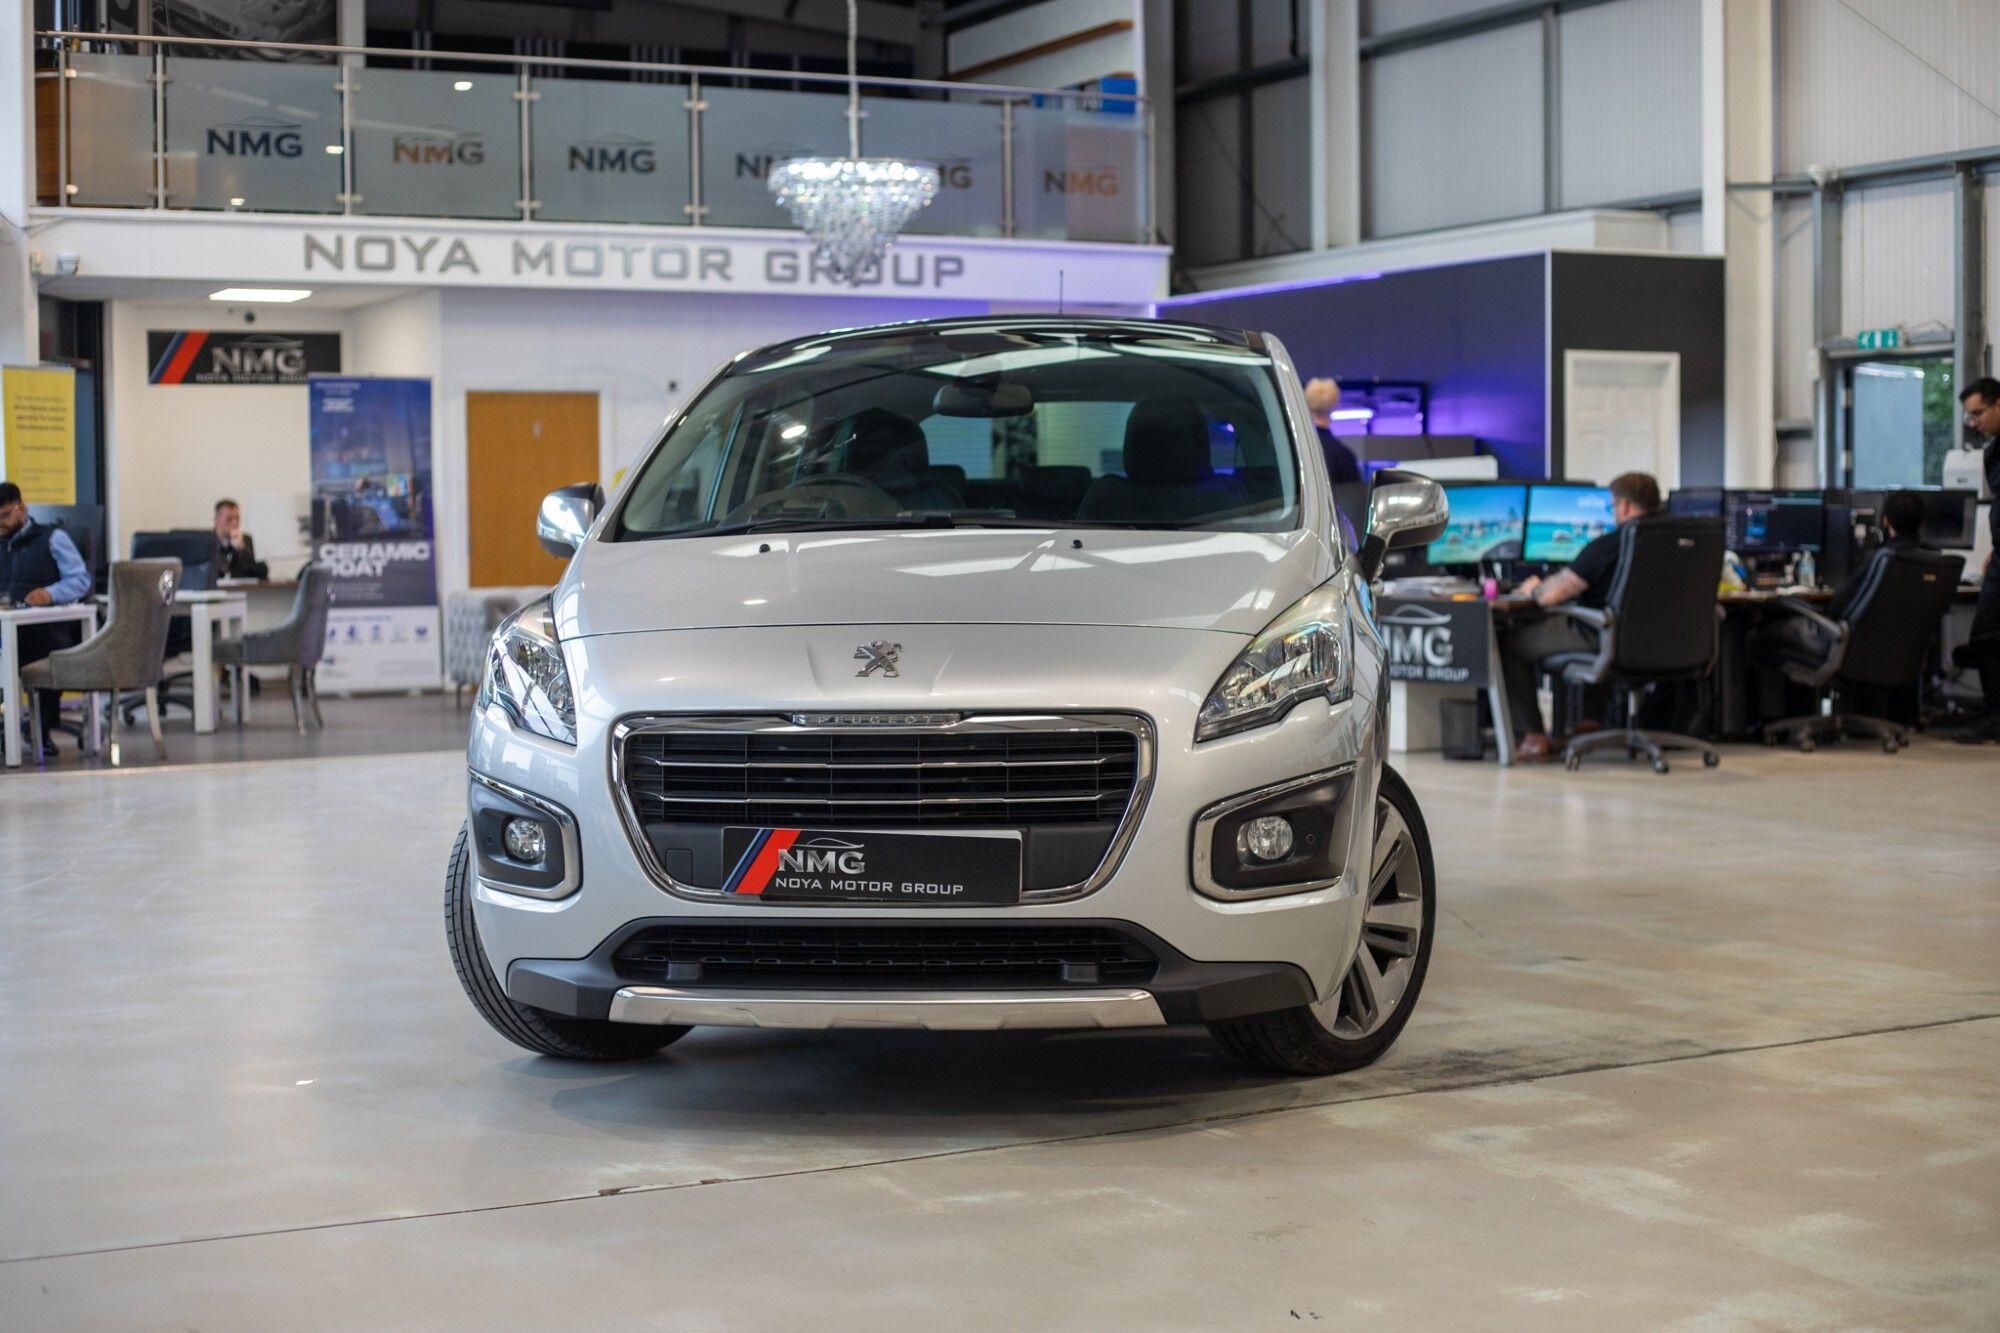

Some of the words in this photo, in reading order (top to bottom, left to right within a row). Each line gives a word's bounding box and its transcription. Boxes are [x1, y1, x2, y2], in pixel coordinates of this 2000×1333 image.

[206, 128, 303, 158] NMG
[391, 137, 486, 165] NMG
[567, 145, 656, 174] NMG
[1043, 168, 1119, 197] NMG
[303, 233, 480, 274] NOYA
[511, 238, 733, 282] MOTOR
[211, 346, 307, 375] NMG
[319, 542, 431, 561] CERAMIC
[1426, 666, 1470, 682] GROUP
[817, 714, 931, 725] PEUGEOT
[777, 848, 866, 875] NMG
[775, 877, 822, 891] NOYA
[830, 880, 893, 894] MOTOR
[901, 882, 964, 896] GROUP
